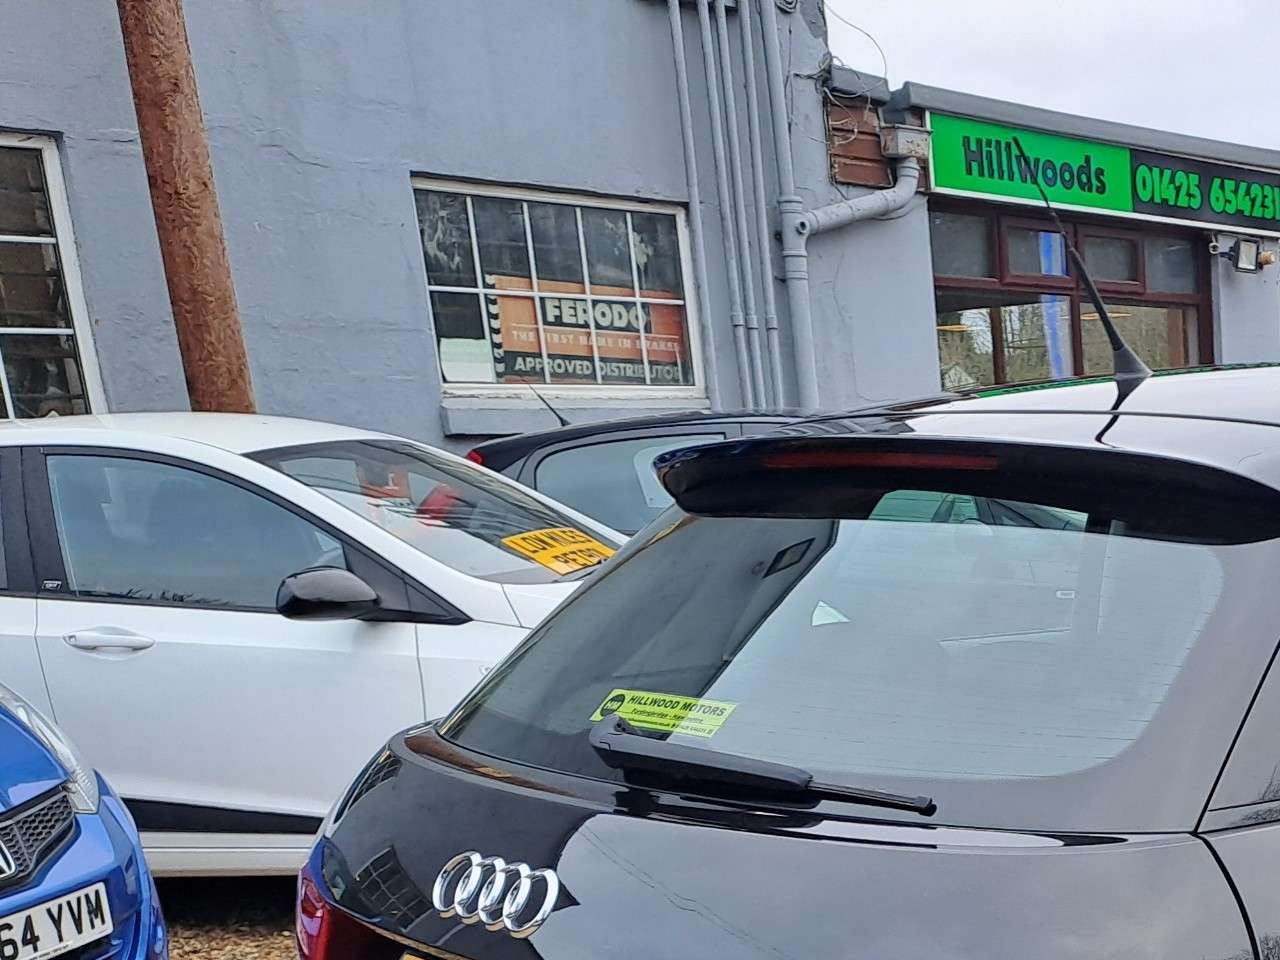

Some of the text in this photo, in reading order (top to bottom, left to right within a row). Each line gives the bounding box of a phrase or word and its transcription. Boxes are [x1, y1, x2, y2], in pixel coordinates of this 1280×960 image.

[962, 135, 1280, 220] Hillwoods 01425 654231
[545, 298, 647, 328] FERODO
[512, 330, 537, 342] THE
[514, 357, 592, 376] APPROVED
[627, 695, 728, 718] HILLWOOD MOTORS
[46, 889, 106, 943] YVM
